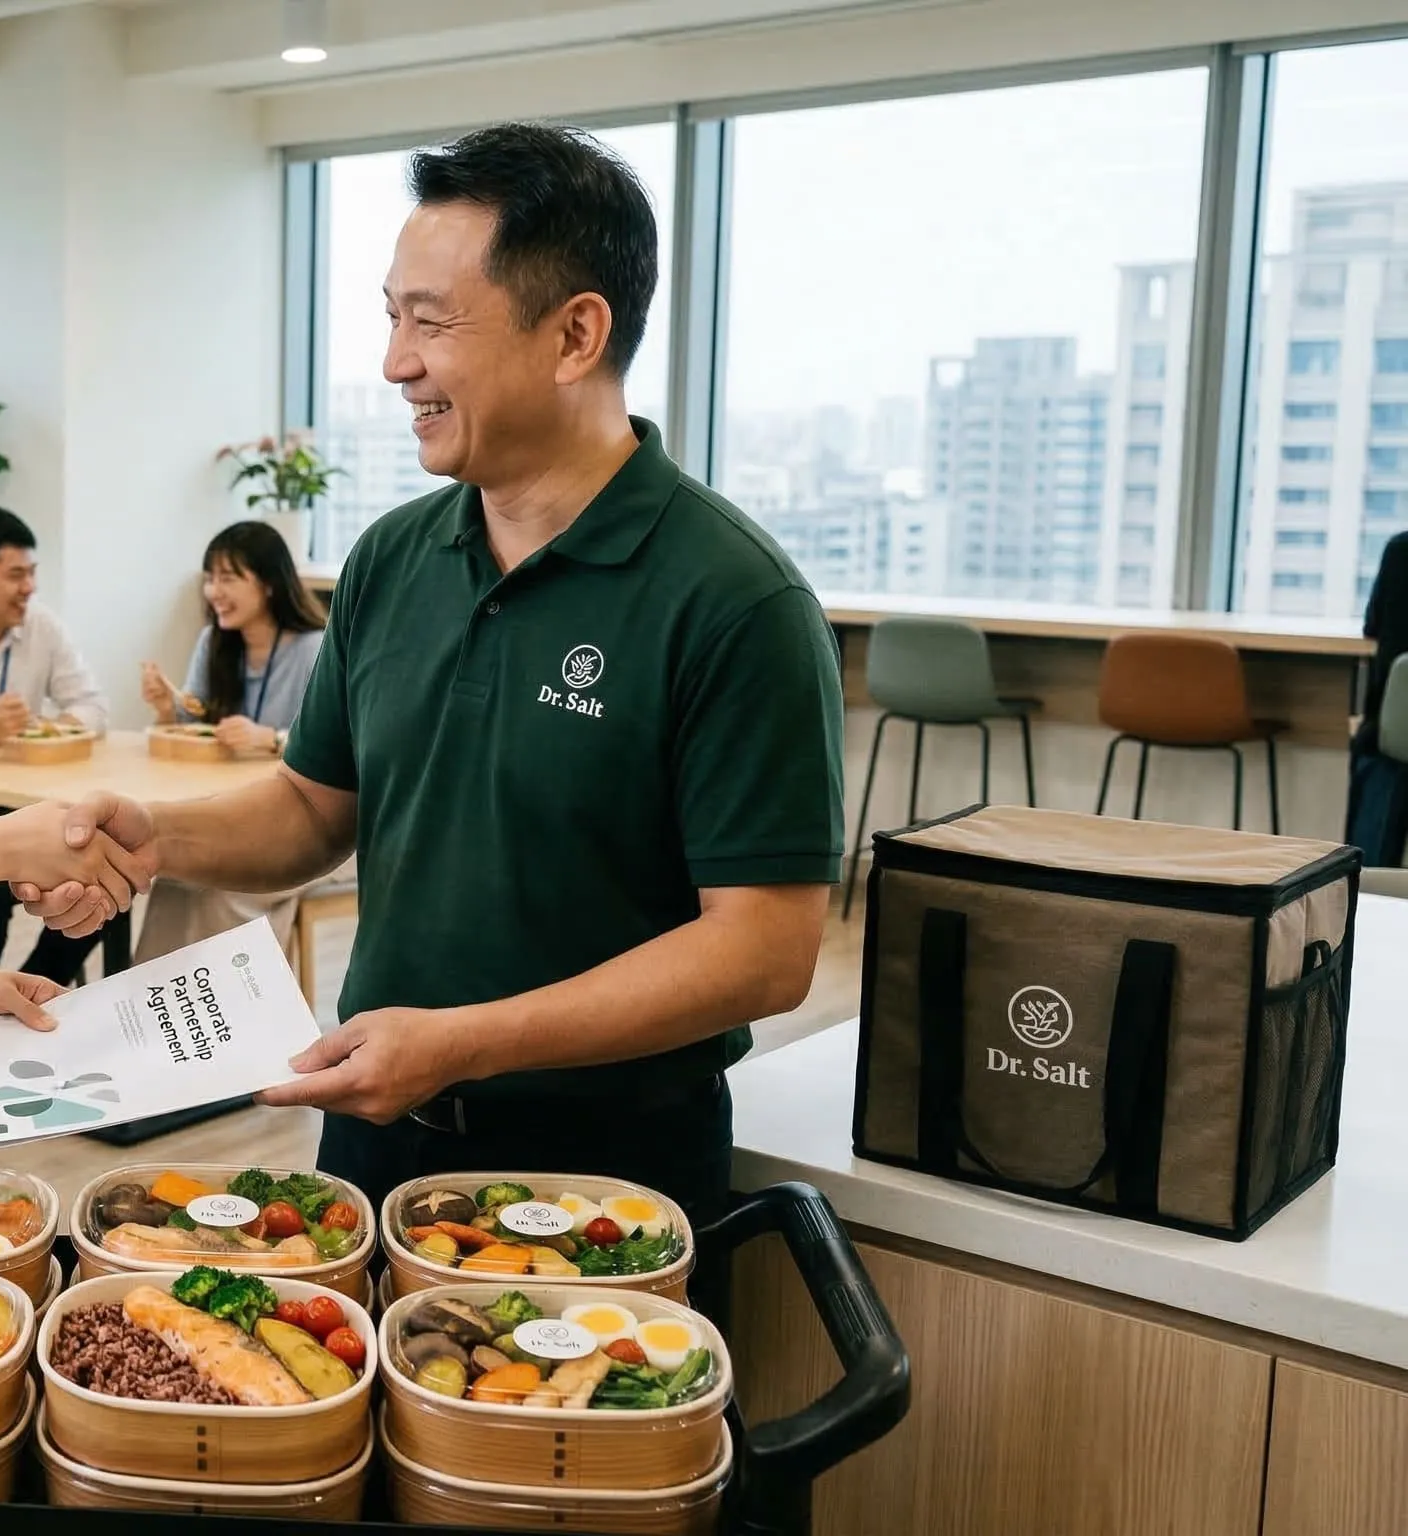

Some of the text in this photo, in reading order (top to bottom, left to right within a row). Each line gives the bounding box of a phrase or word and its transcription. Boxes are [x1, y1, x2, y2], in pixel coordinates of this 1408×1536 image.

[537, 685, 604, 718] Dr. Salt
[147, 986, 190, 1063] Agreement
[169, 975, 215, 1061] Partnership
[193, 967, 232, 1043] Corporate
[986, 1047, 1091, 1089] Dr. Salt
